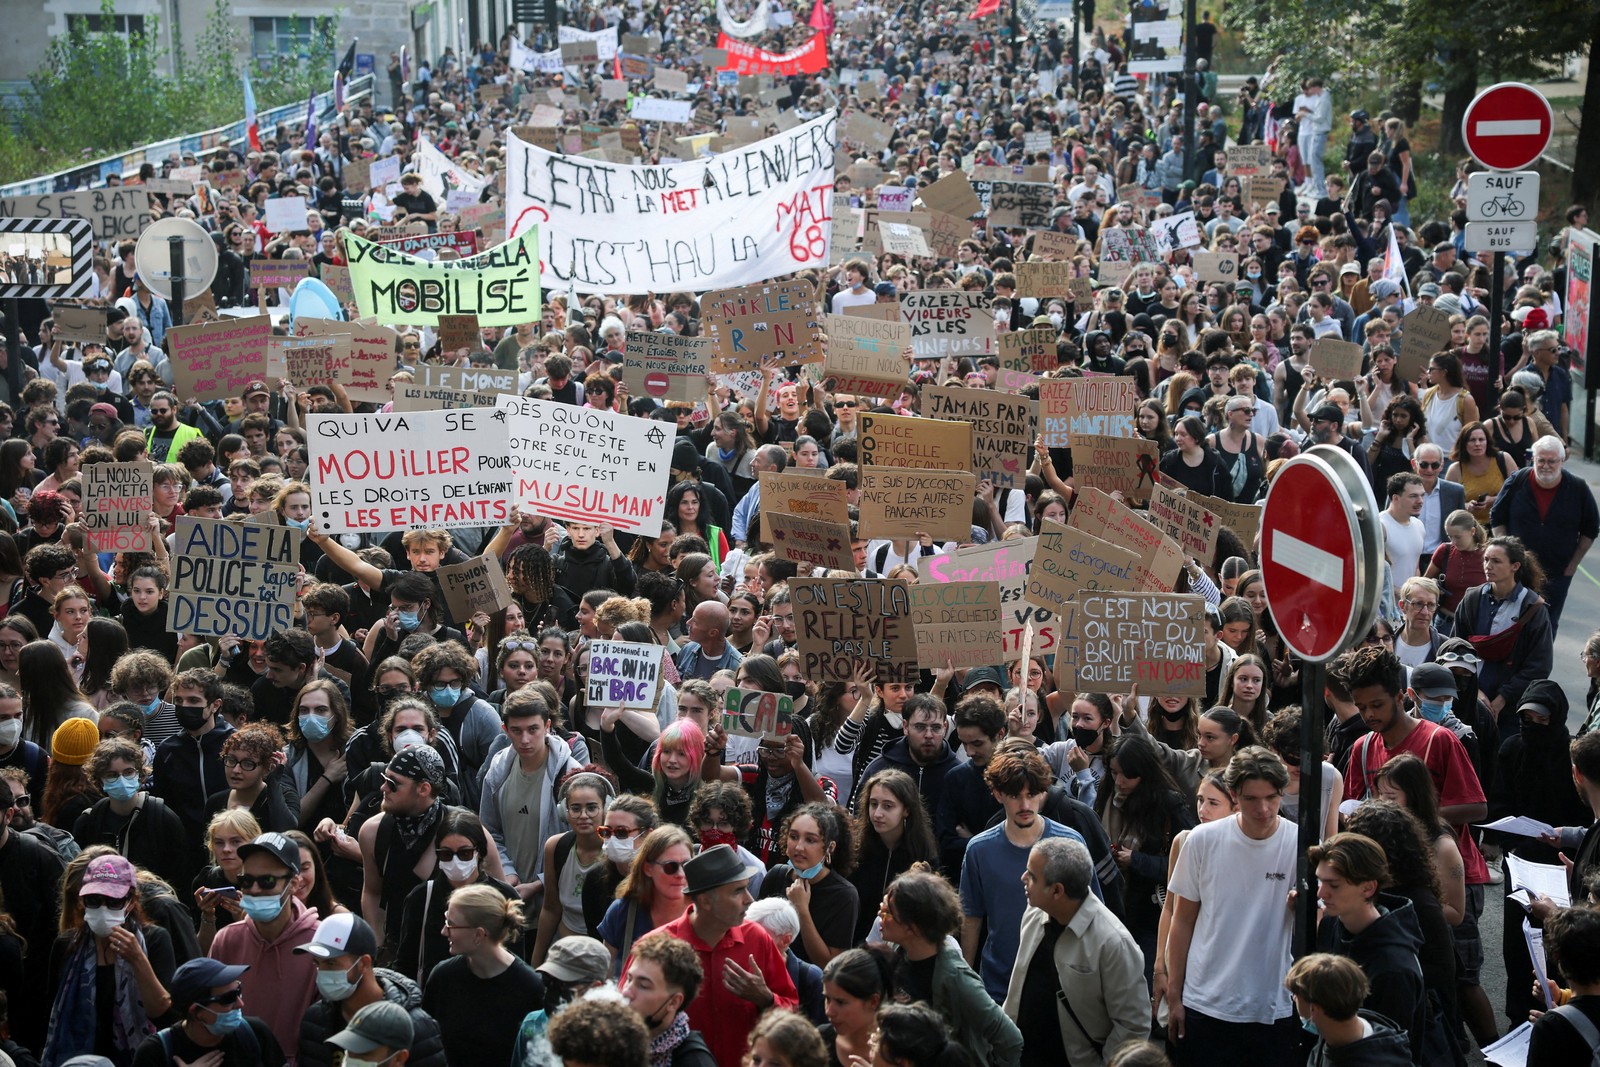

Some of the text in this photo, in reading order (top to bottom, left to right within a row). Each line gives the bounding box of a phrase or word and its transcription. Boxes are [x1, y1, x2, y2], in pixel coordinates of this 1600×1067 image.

[631, 168, 678, 192] NOUS
[1486, 177, 1524, 189] SAUF
[35, 189, 142, 218] SE BAT
[637, 194, 658, 214] LA
[660, 188, 701, 214] MET
[732, 235, 760, 262] LA
[776, 184, 833, 232] MAI
[1487, 227, 1516, 236] SAUF
[789, 225, 826, 263] 68
[1490, 238, 1511, 246] BUS
[1220, 259, 1235, 275] hp
[370, 268, 530, 315] MOBILISÉ
[907, 293, 992, 309] GAZEZ LES
[903, 307, 972, 321] VIOLEURS
[1416, 306, 1446, 327] RIP
[834, 319, 905, 340] PARCOURSUP
[937, 319, 967, 335] LES
[626, 332, 657, 346] METTEZ
[662, 336, 675, 347] LE
[731, 322, 795, 353] R N
[830, 335, 854, 350] NOUS
[626, 345, 644, 355] POUR
[683, 351, 697, 360] PAS
[325, 356, 350, 370] BAC
[626, 359, 667, 370] POUR NOUS
[877, 359, 903, 374] NOUS
[1004, 356, 1031, 372] PAS
[461, 372, 514, 391] MONDE
[405, 388, 421, 398] LES
[1039, 378, 1135, 413] GAZEZ VIOLEURS
[442, 400, 454, 410] LE
[997, 402, 1027, 422] PAR
[1046, 399, 1069, 415] LES
[445, 413, 477, 431] SE
[552, 407, 615, 432] QU'ON
[862, 416, 914, 439] POLICE
[1045, 416, 1070, 433] PAS
[539, 422, 627, 452] PROTESTE
[976, 436, 1027, 456] N'AUREZ
[1045, 432, 1069, 447] LES
[1074, 435, 1119, 449] ILS SONT
[862, 436, 941, 459] OFFICIELLE
[478, 455, 512, 471] POUR
[554, 443, 657, 473] SEUL MOT EN
[1092, 449, 1131, 468] GRANDS
[90, 465, 142, 484] IL NOUS
[575, 464, 618, 482] C'EST
[1074, 463, 1126, 477] CAR SOMMES
[87, 483, 139, 498] LA MET
[769, 481, 787, 494] PAS
[863, 475, 963, 491] JE SUIS D'ACCORD
[1095, 475, 1136, 493] GENOUX
[319, 489, 354, 506] LES
[443, 484, 466, 499] DE
[468, 481, 513, 496] L'ENFANT
[863, 491, 965, 505] AVEC LES AUTRES
[1159, 490, 1177, 510] DANS
[1177, 501, 1186, 515] LA
[85, 495, 151, 513] L'ENVERS
[884, 505, 947, 519] PANCARTES
[86, 510, 140, 529] ON LUI
[344, 500, 507, 528] LES ENFANTS
[86, 524, 147, 551] MAI 68
[185, 523, 293, 563] AIDE LA
[1041, 532, 1063, 554] Ils
[174, 556, 297, 598] POLICE tape
[446, 564, 489, 586] FASHION
[257, 584, 279, 603] toi
[463, 579, 487, 595] PAS
[794, 580, 910, 617] ON EST LA
[173, 595, 291, 641] DESSUS
[941, 608, 998, 624] DÉCHETS
[1083, 597, 1194, 620] C'EST NOUS
[940, 629, 977, 644] FAITES
[980, 630, 1001, 644] PAS
[1084, 619, 1196, 643] ON FAIT DU
[832, 640, 893, 660] PAS LE
[937, 647, 998, 665] MINISTRES
[1085, 639, 1206, 664] BRUIT PENDANT
[622, 657, 639, 679] ON
[1080, 661, 1205, 684] QUE LE FN DORT
[588, 678, 649, 702] LA BAC
[723, 688, 794, 737] ACAB
